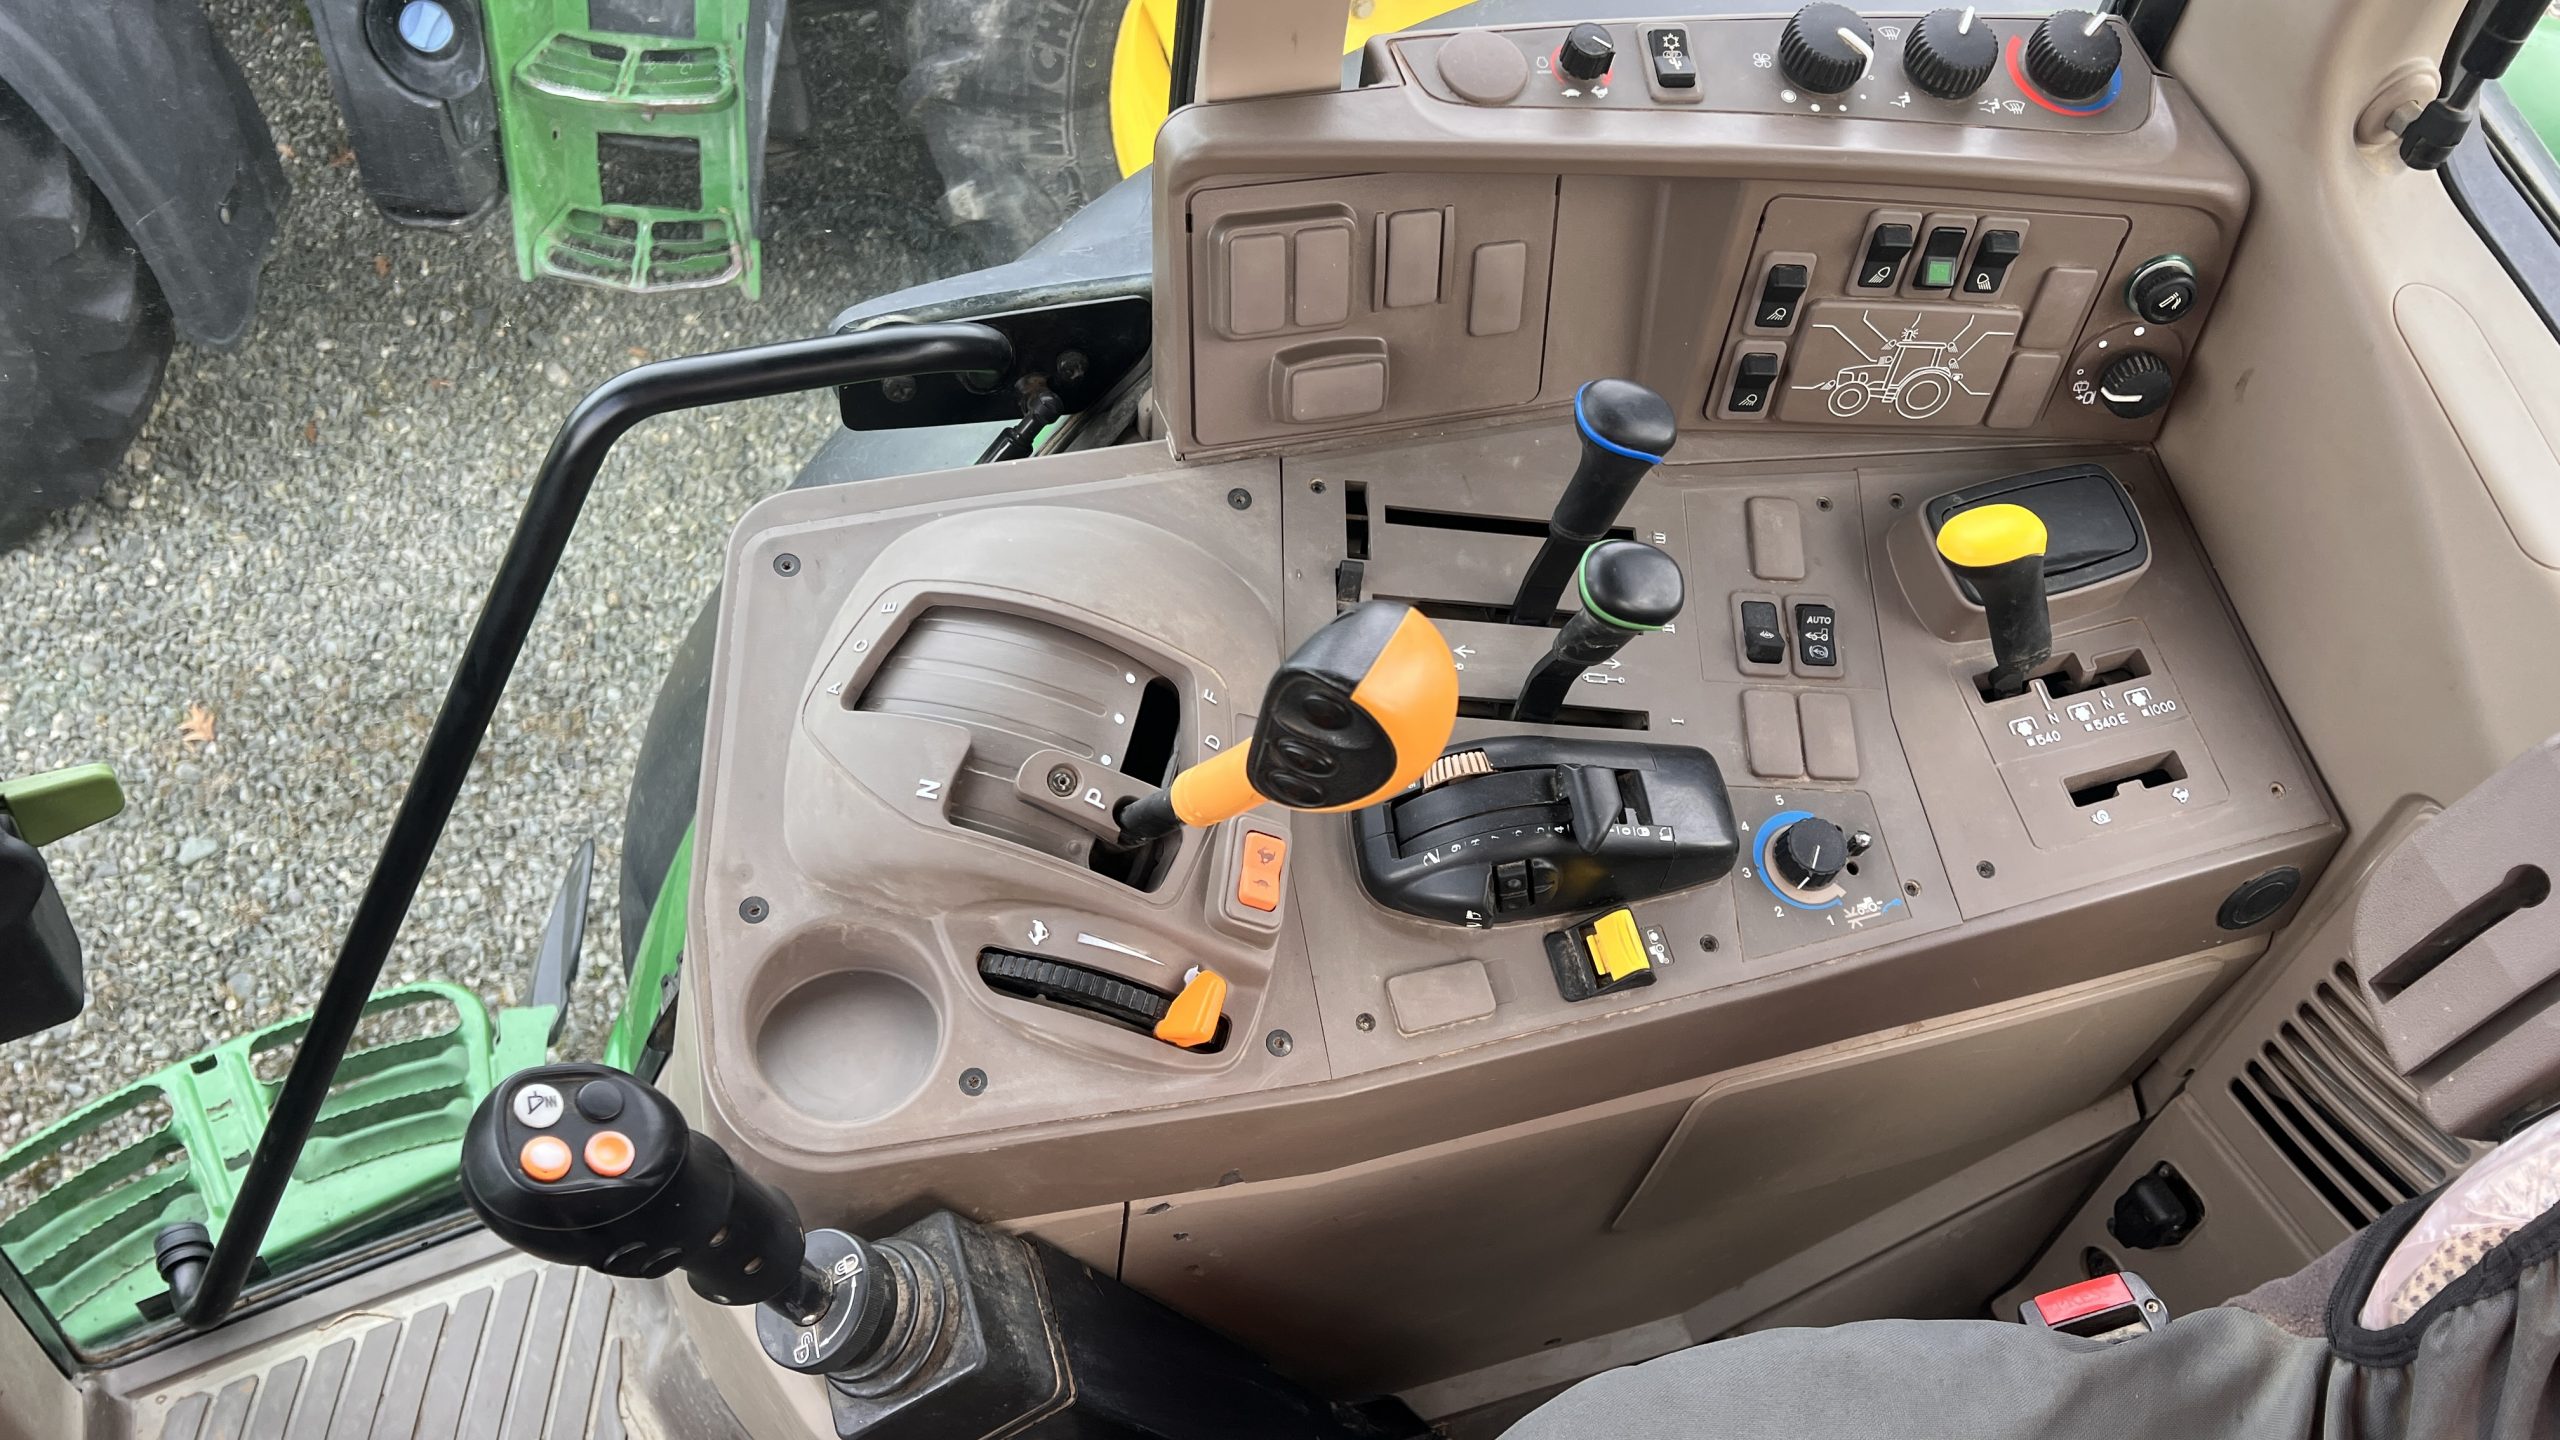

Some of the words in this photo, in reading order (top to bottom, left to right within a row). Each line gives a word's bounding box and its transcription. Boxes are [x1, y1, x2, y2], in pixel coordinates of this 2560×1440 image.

[881, 602, 897, 613] E
[1806, 616, 1832, 625] AUTO
[853, 640, 868, 652] C
[827, 682, 842, 695] A
[1203, 688, 1218, 705] F
[2100, 697, 2115, 710] N
[2150, 700, 2177, 717] 1000
[2047, 713, 2060, 725] N
[1204, 734, 1220, 750] D
[2035, 730, 2061, 746] 540
[915, 778, 942, 800] N
[1084, 787, 1106, 810] P
[1775, 794, 1785, 806] 5
[1554, 825, 1564, 834] 4
[1741, 821, 1750, 832] 4
[1742, 867, 1752, 878] 3
[1774, 906, 1785, 918] 2
[1826, 915, 1835, 926] 1
